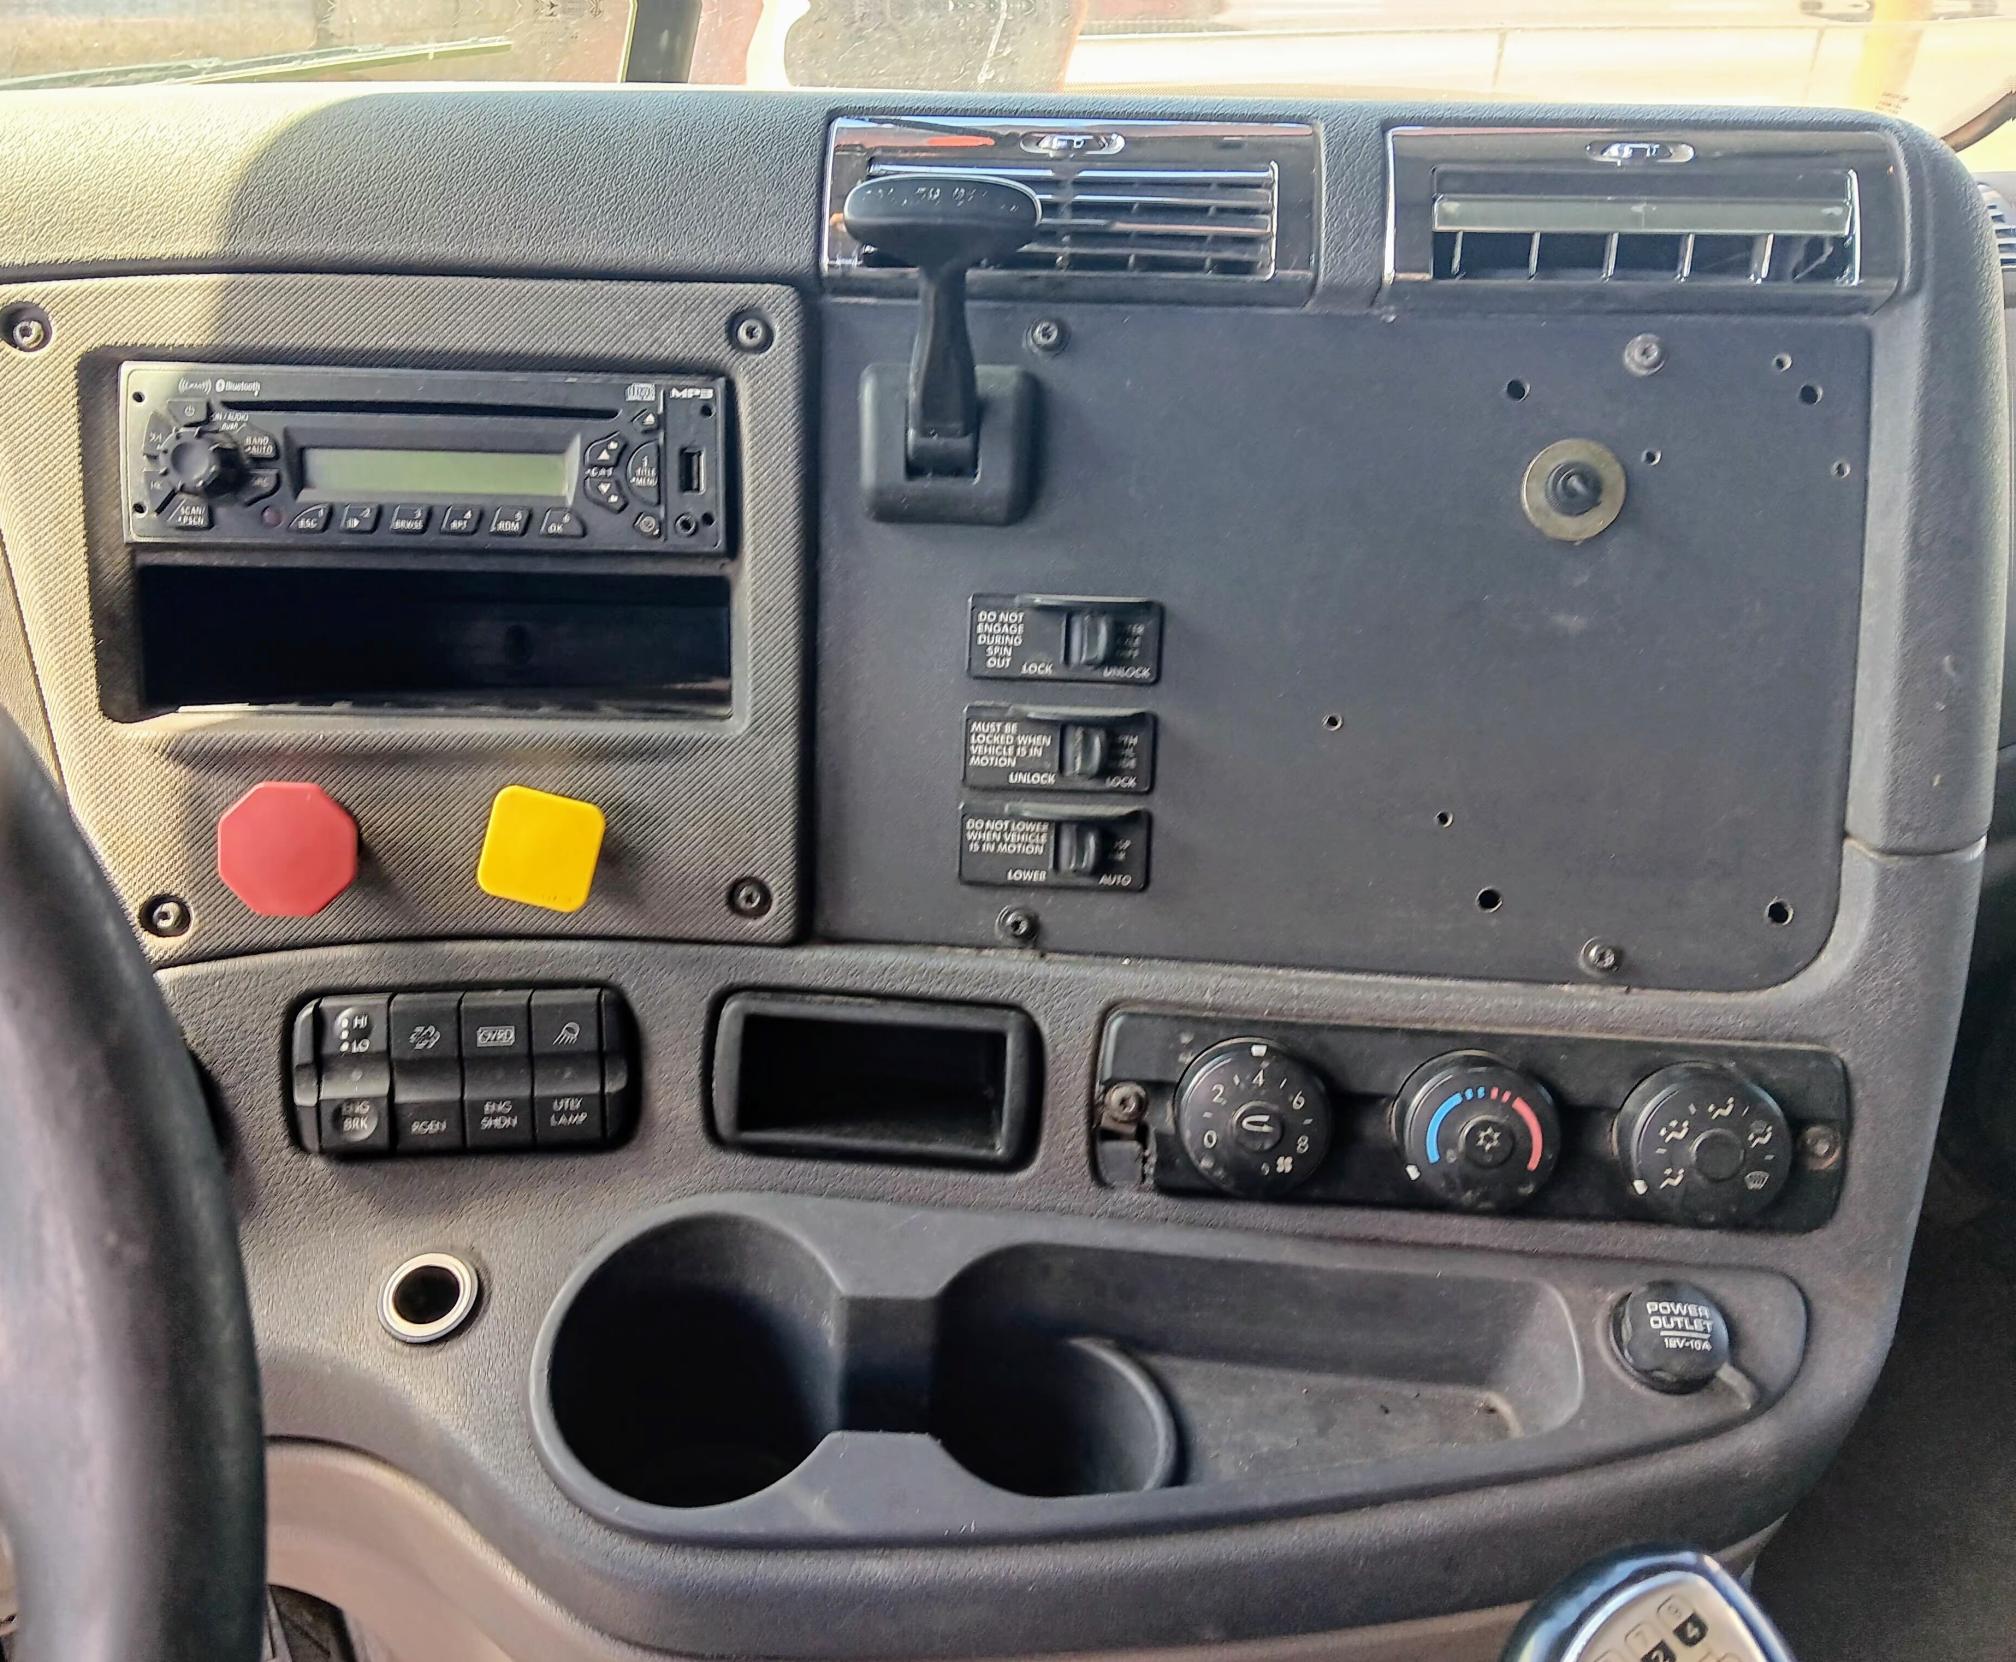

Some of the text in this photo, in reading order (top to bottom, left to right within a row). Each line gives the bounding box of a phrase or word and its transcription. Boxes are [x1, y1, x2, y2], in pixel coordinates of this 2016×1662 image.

[226, 381, 261, 397] Bluetooth
[670, 387, 714, 399] MP3
[360, 507, 371, 518] 2
[413, 508, 422, 519] 3
[464, 510, 472, 520] 4
[514, 512, 523, 521] 5
[563, 513, 571, 523] 6
[298, 518, 318, 529] ESC
[496, 520, 520, 532] RDM
[548, 523, 564, 534] OK
[978, 610, 1025, 623] DO NOT
[976, 622, 1024, 635] ENGAGE
[976, 633, 1023, 646] DURING
[985, 645, 1013, 657] SPIN
[986, 657, 1012, 669] OUT
[1020, 662, 1054, 675] LOCK
[1103, 666, 1151, 679] UNLOCK
[970, 721, 1019, 734] MUST BE
[970, 733, 1052, 747] LOCKED WHEN
[970, 744, 1043, 758] VEHICLE IS IN
[969, 756, 1017, 768] MOTION
[1008, 771, 1057, 785] UNLOCK
[1105, 775, 1137, 788] LOCK
[966, 819, 1049, 833] DO NOT LOWER
[966, 830, 1048, 844] WHEN VEHICLE
[968, 841, 1044, 855] IS IN MOTION
[1007, 868, 1047, 882] LOWER
[1098, 873, 1132, 887] AUTO
[353, 1014, 369, 1029] HI
[352, 1038, 370, 1053] LO
[1252, 1069, 1265, 1087] 4
[1212, 1084, 1225, 1103] 2
[1292, 1090, 1305, 1110] 6
[342, 1100, 370, 1115] ENG
[484, 1100, 512, 1115] ENG
[343, 1116, 368, 1132] BRK
[550, 1112, 588, 1127] LAMP
[1203, 1130, 1217, 1149] 0
[1296, 1135, 1310, 1154] 8
[1646, 1301, 1711, 1319] POWER
[1649, 1316, 1714, 1333] OUTLET
[1664, 1337, 1713, 1352] 12V-10A
[1686, 1621, 1700, 1639] 4
